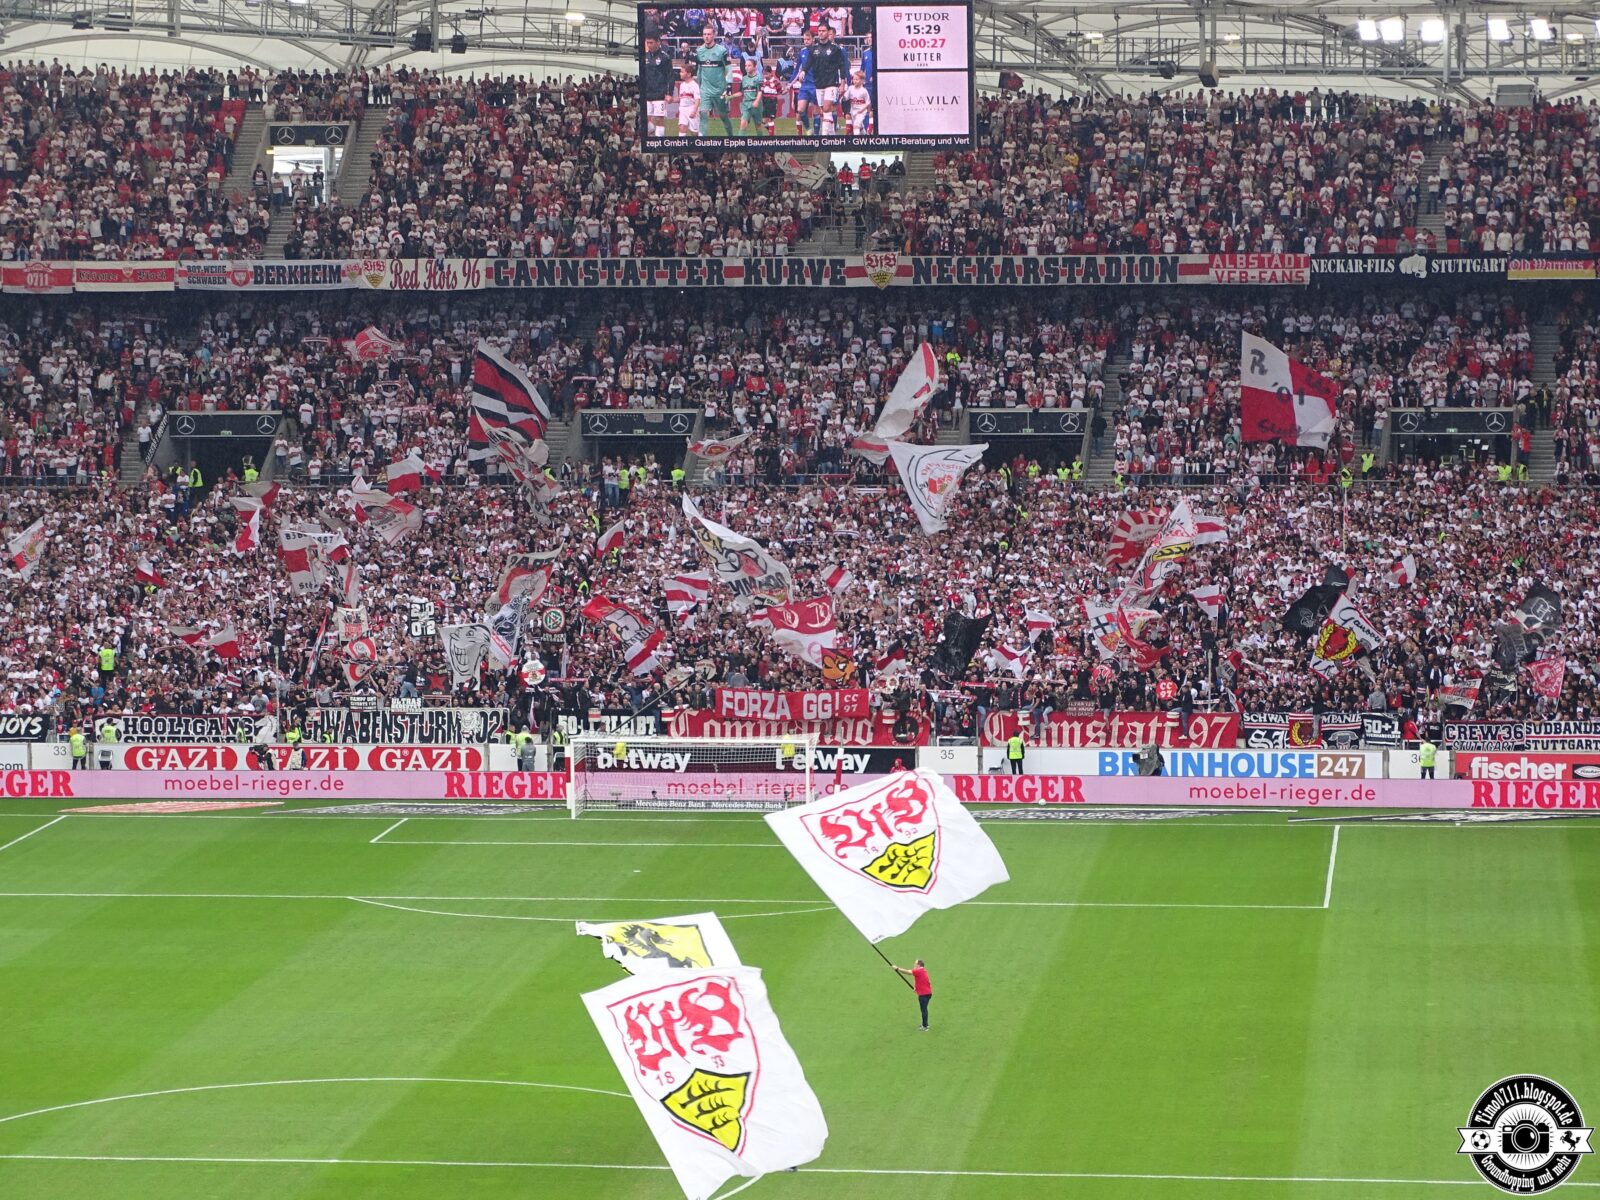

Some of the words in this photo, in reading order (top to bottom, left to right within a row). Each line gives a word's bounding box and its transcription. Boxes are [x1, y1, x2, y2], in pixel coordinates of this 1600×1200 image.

[905, 12, 950, 21] TUDOR
[905, 24, 941, 35] 15:29
[898, 38, 946, 49] 0:00:27
[903, 53, 942, 62] KUTTER
[664, 139, 688, 147] GmbH
[695, 139, 722, 147] Gustav
[724, 139, 746, 148] Epple
[747, 138, 820, 147] Bauwerkserhaltung
[821, 138, 846, 146] GmbH
[852, 137, 869, 146] GW
[869, 137, 890, 146] KOM
[891, 137, 936, 147] IT-Beratung
[937, 137, 951, 146] und
[953, 137, 970, 145] Vert
[1212, 254, 1309, 269] ALBSTADT
[1311, 258, 1395, 273] NECKAR-FILS
[1431, 257, 1508, 273] STUTTGART
[1508, 258, 1531, 271] Old
[1532, 258, 1585, 271] Warriors
[253, 264, 342, 285] BERKHEIM
[390, 258, 421, 290] Red
[424, 258, 458, 289] Hots
[462, 257, 481, 289] 96
[493, 259, 725, 287] CANNSTATTER
[743, 258, 847, 286] KURVE
[912, 256, 1180, 285] NECKARSTADION
[1215, 270, 1305, 284] VFB-FANS
[187, 276, 227, 285] SCHWABEN
[721, 690, 792, 720] FORZA
[802, 692, 840, 720] GG!
[844, 692, 859, 702] CC
[843, 703, 859, 713] 97
[1243, 712, 1290, 724] SCHWA
[122, 717, 255, 736] HOOLIGANS
[1189, 715, 1232, 749] 97
[1445, 724, 1500, 741] CREW
[1502, 724, 1524, 741] 36
[53, 746, 67, 756] 33
[1525, 739, 1600, 751] STUTTGART
[940, 750, 955, 760] 35
[1098, 751, 1315, 778] BRINHOUSE
[1320, 756, 1363, 777] 247
[1471, 757, 1568, 780] fischer
[0, 770, 74, 797] GER
[164, 774, 345, 795] moebel-rieger.de
[444, 772, 566, 799] RIEGER
[953, 775, 1086, 803] RIEGER
[1189, 782, 1376, 806] moebel-rieger.de
[1471, 781, 1600, 809] RIEGER
[635, 800, 688, 808] Mercedes-Benz
[711, 801, 763, 809] Mercedes-Benz
[655, 1070, 676, 1087] 18
